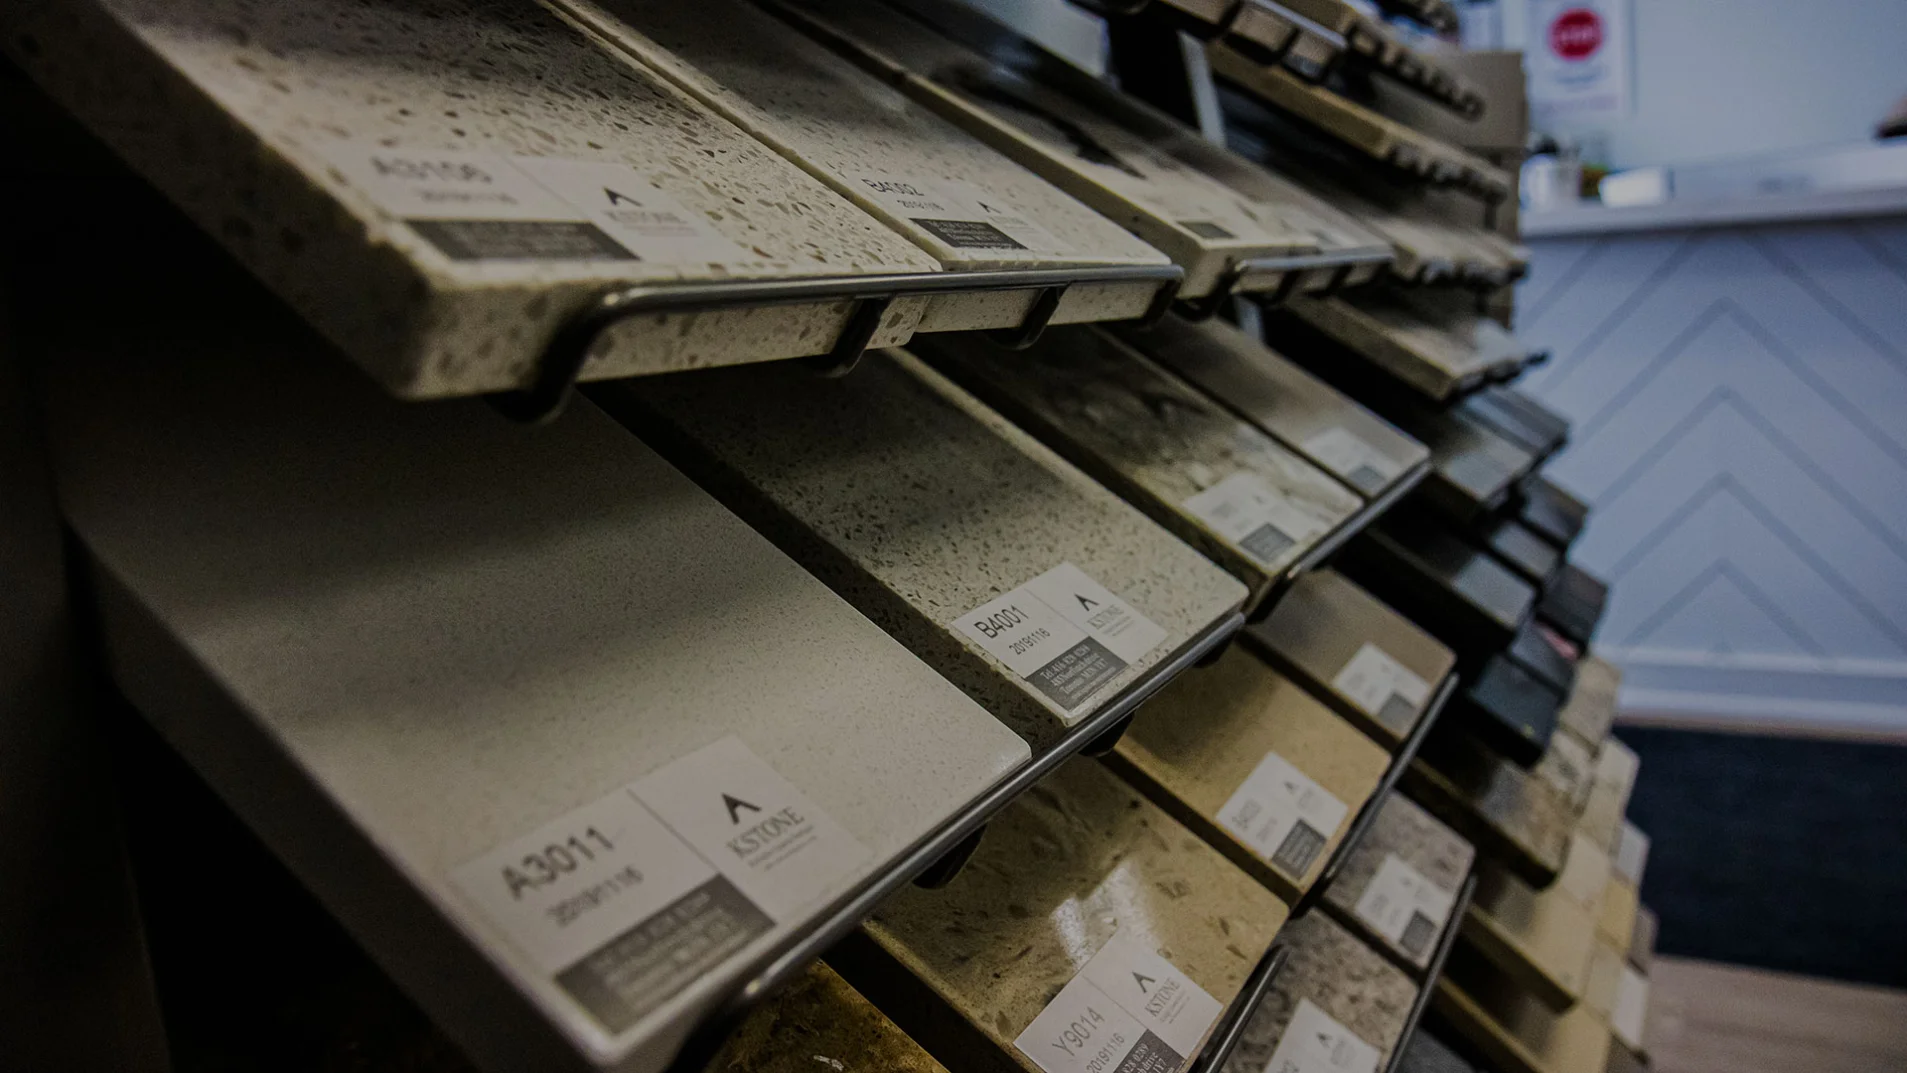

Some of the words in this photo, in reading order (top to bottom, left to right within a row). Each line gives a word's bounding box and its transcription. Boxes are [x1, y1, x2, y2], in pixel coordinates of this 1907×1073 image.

[974, 603, 1029, 639] B4001
[1009, 627, 1051, 656] 20191116
[725, 806, 805, 859] KSTONE
[501, 825, 615, 901] A3011
[1144, 976, 1181, 1018] KSTONE
[1052, 1005, 1105, 1057] Y9014
[1085, 1031, 1125, 1073] 20191116
